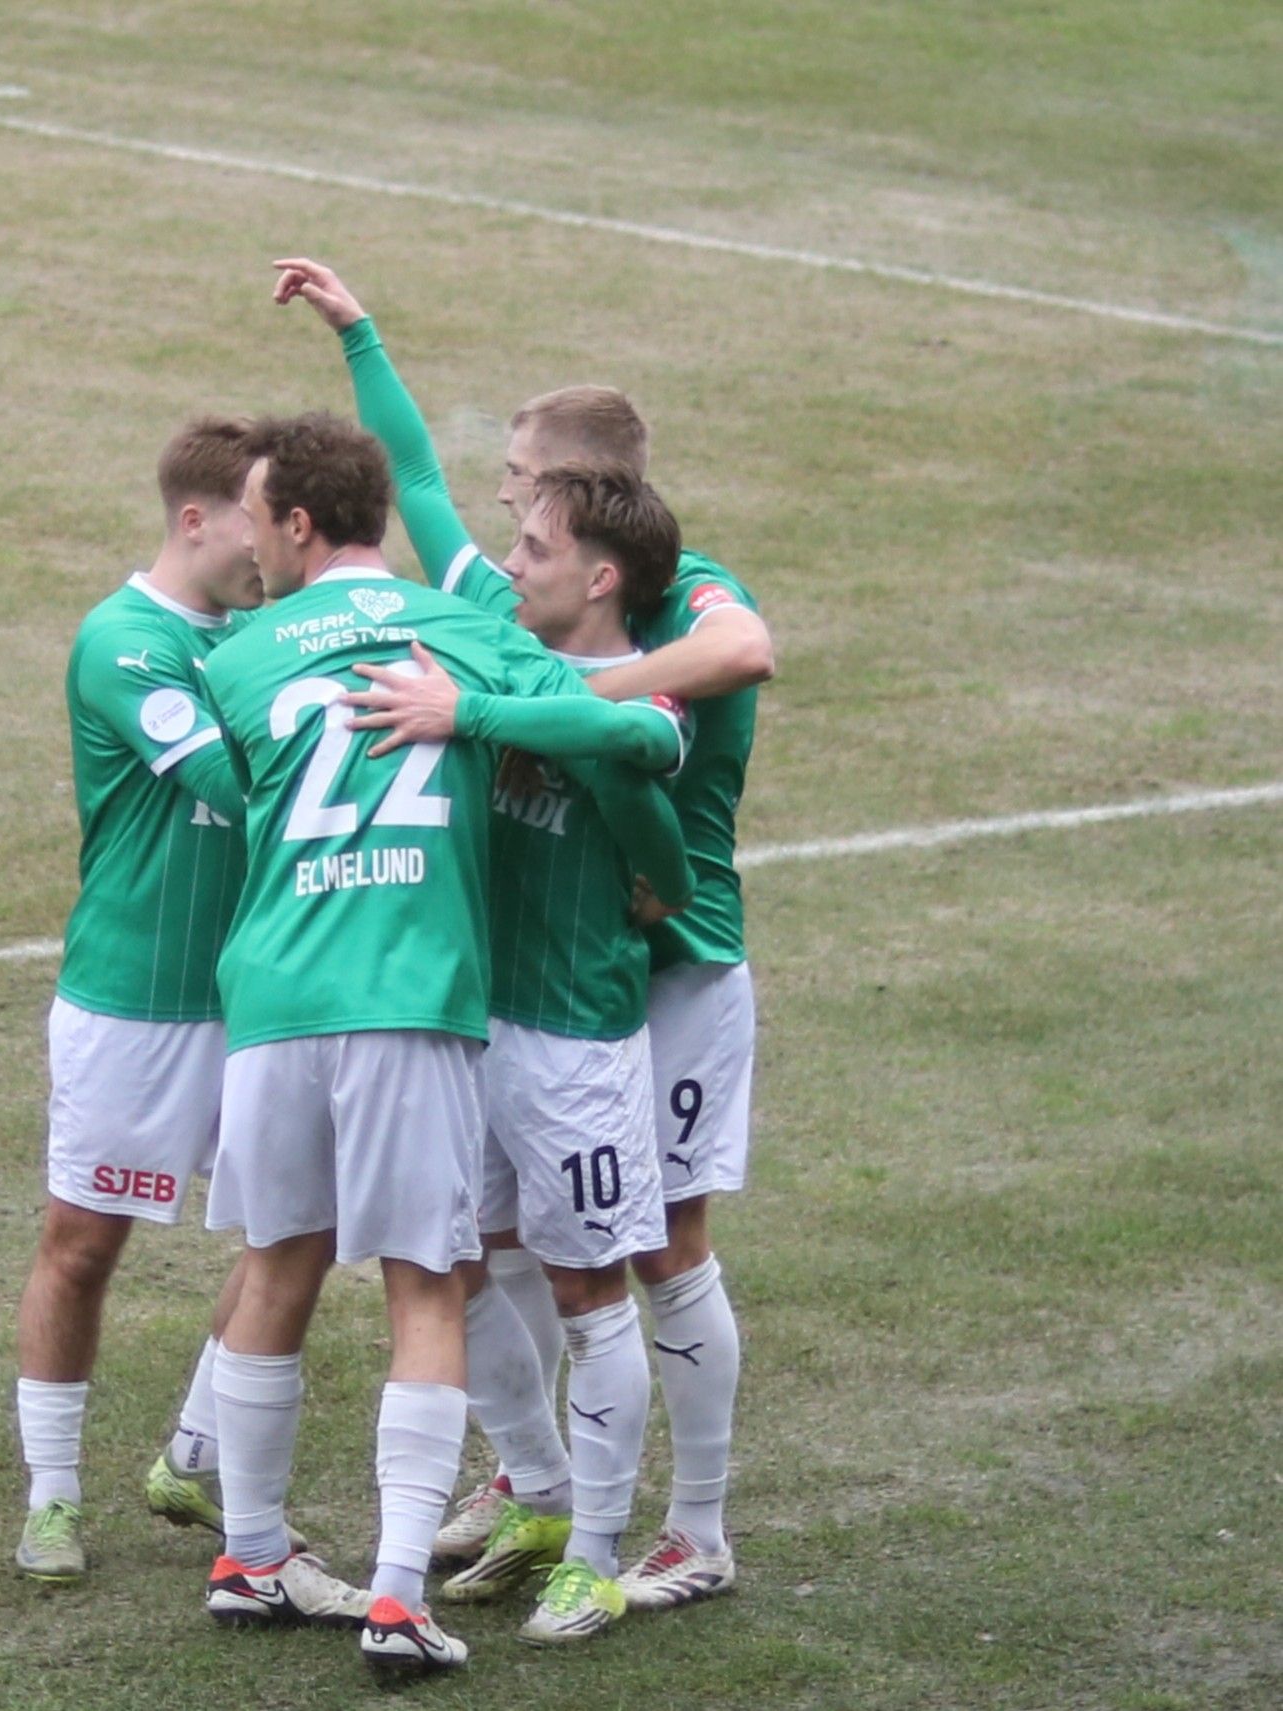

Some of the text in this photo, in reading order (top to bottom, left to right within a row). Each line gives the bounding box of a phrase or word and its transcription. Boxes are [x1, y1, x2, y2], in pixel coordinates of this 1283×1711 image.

[269, 659, 452, 842] 22
[493, 785, 572, 836] NDI
[295, 847, 425, 897] ELMELUND
[669, 1078, 703, 1145] 9
[91, 1164, 177, 1203] SJEB
[560, 1144, 622, 1213] 10
